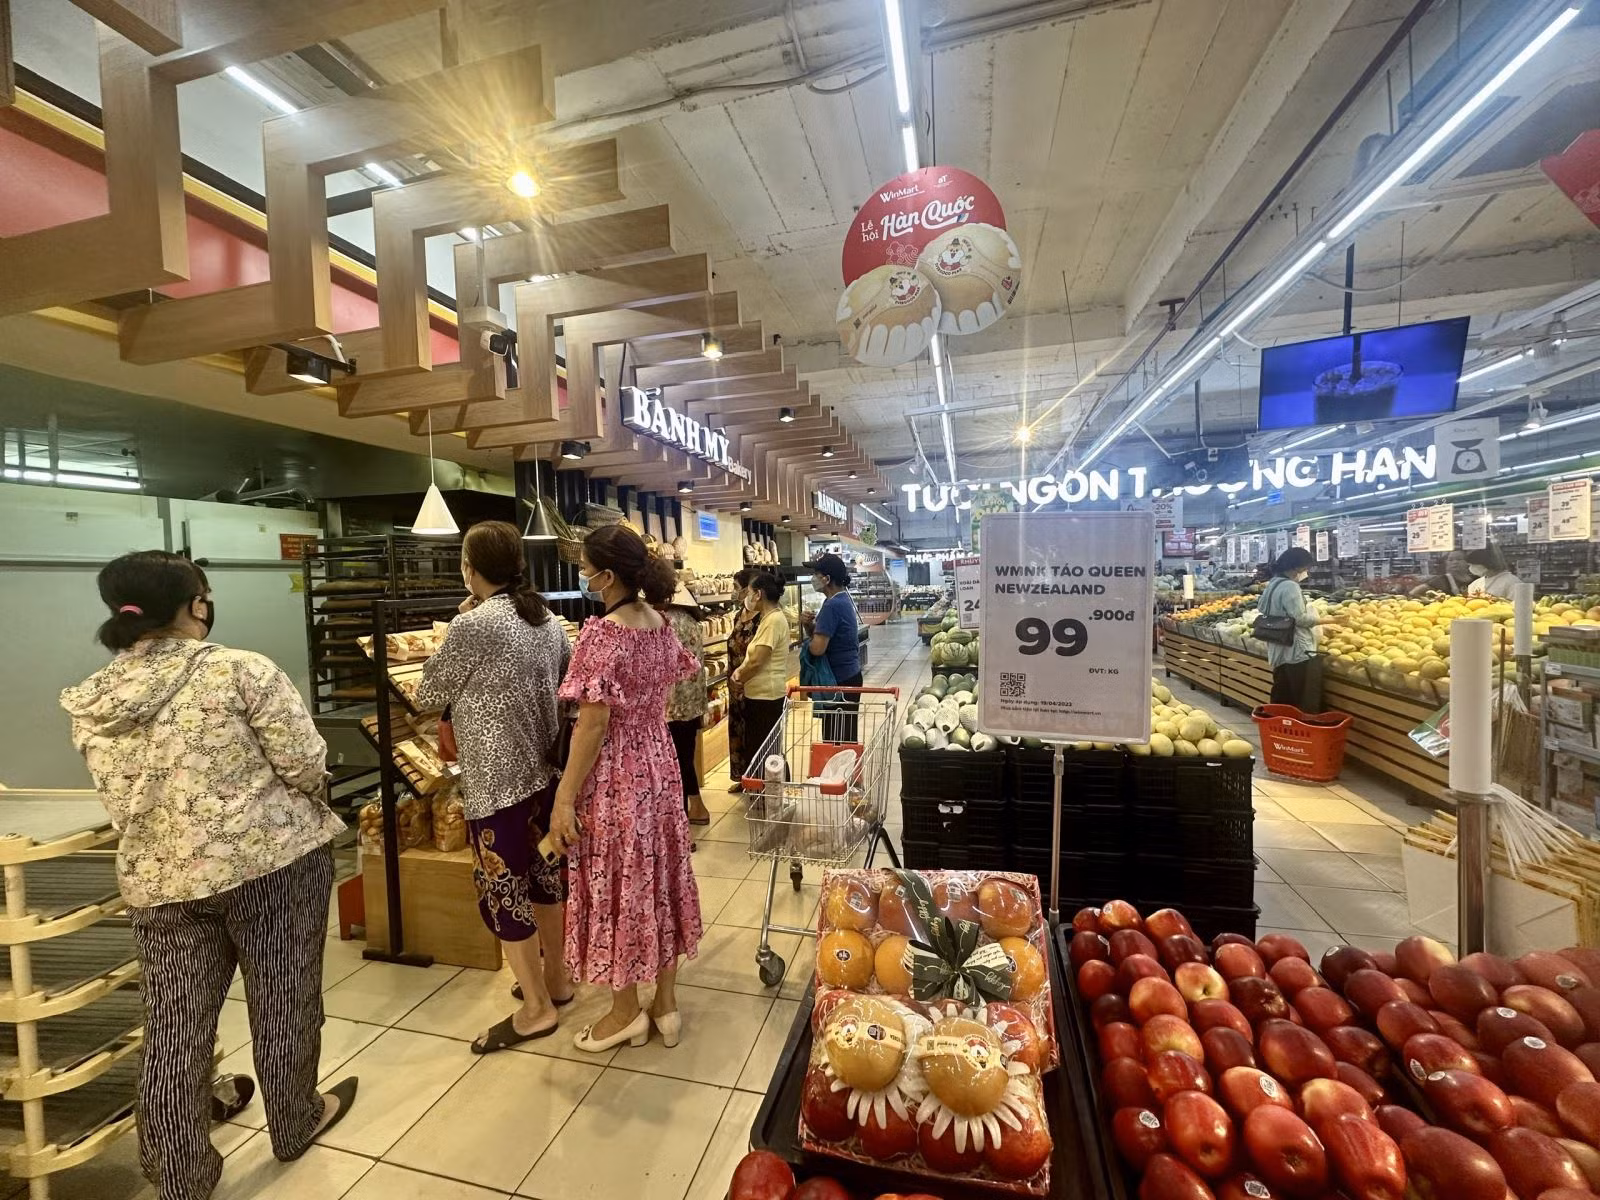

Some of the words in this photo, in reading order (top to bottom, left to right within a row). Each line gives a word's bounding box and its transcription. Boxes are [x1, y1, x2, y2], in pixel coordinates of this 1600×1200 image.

[880, 184, 919, 203] WinMart
[881, 210, 920, 241] Hàn
[920, 195, 975, 230] Quốc
[862, 229, 880, 243] hội
[630, 386, 701, 454] BÁNH
[701, 426, 730, 467] MỲ
[727, 455, 752, 485] Bakery
[901, 478, 991, 513] TƯƠ
[999, 468, 1119, 508] NGON
[1330, 444, 1437, 491] HẠN
[1051, 563, 1084, 577] TÁO
[1088, 565, 1146, 578] QUEEN
[994, 583, 1106, 596] NEWZEALAND
[1015, 617, 1088, 657] 99
[1088, 609, 1135, 621] .900đ
[1273, 742, 1304, 754] WinMart
